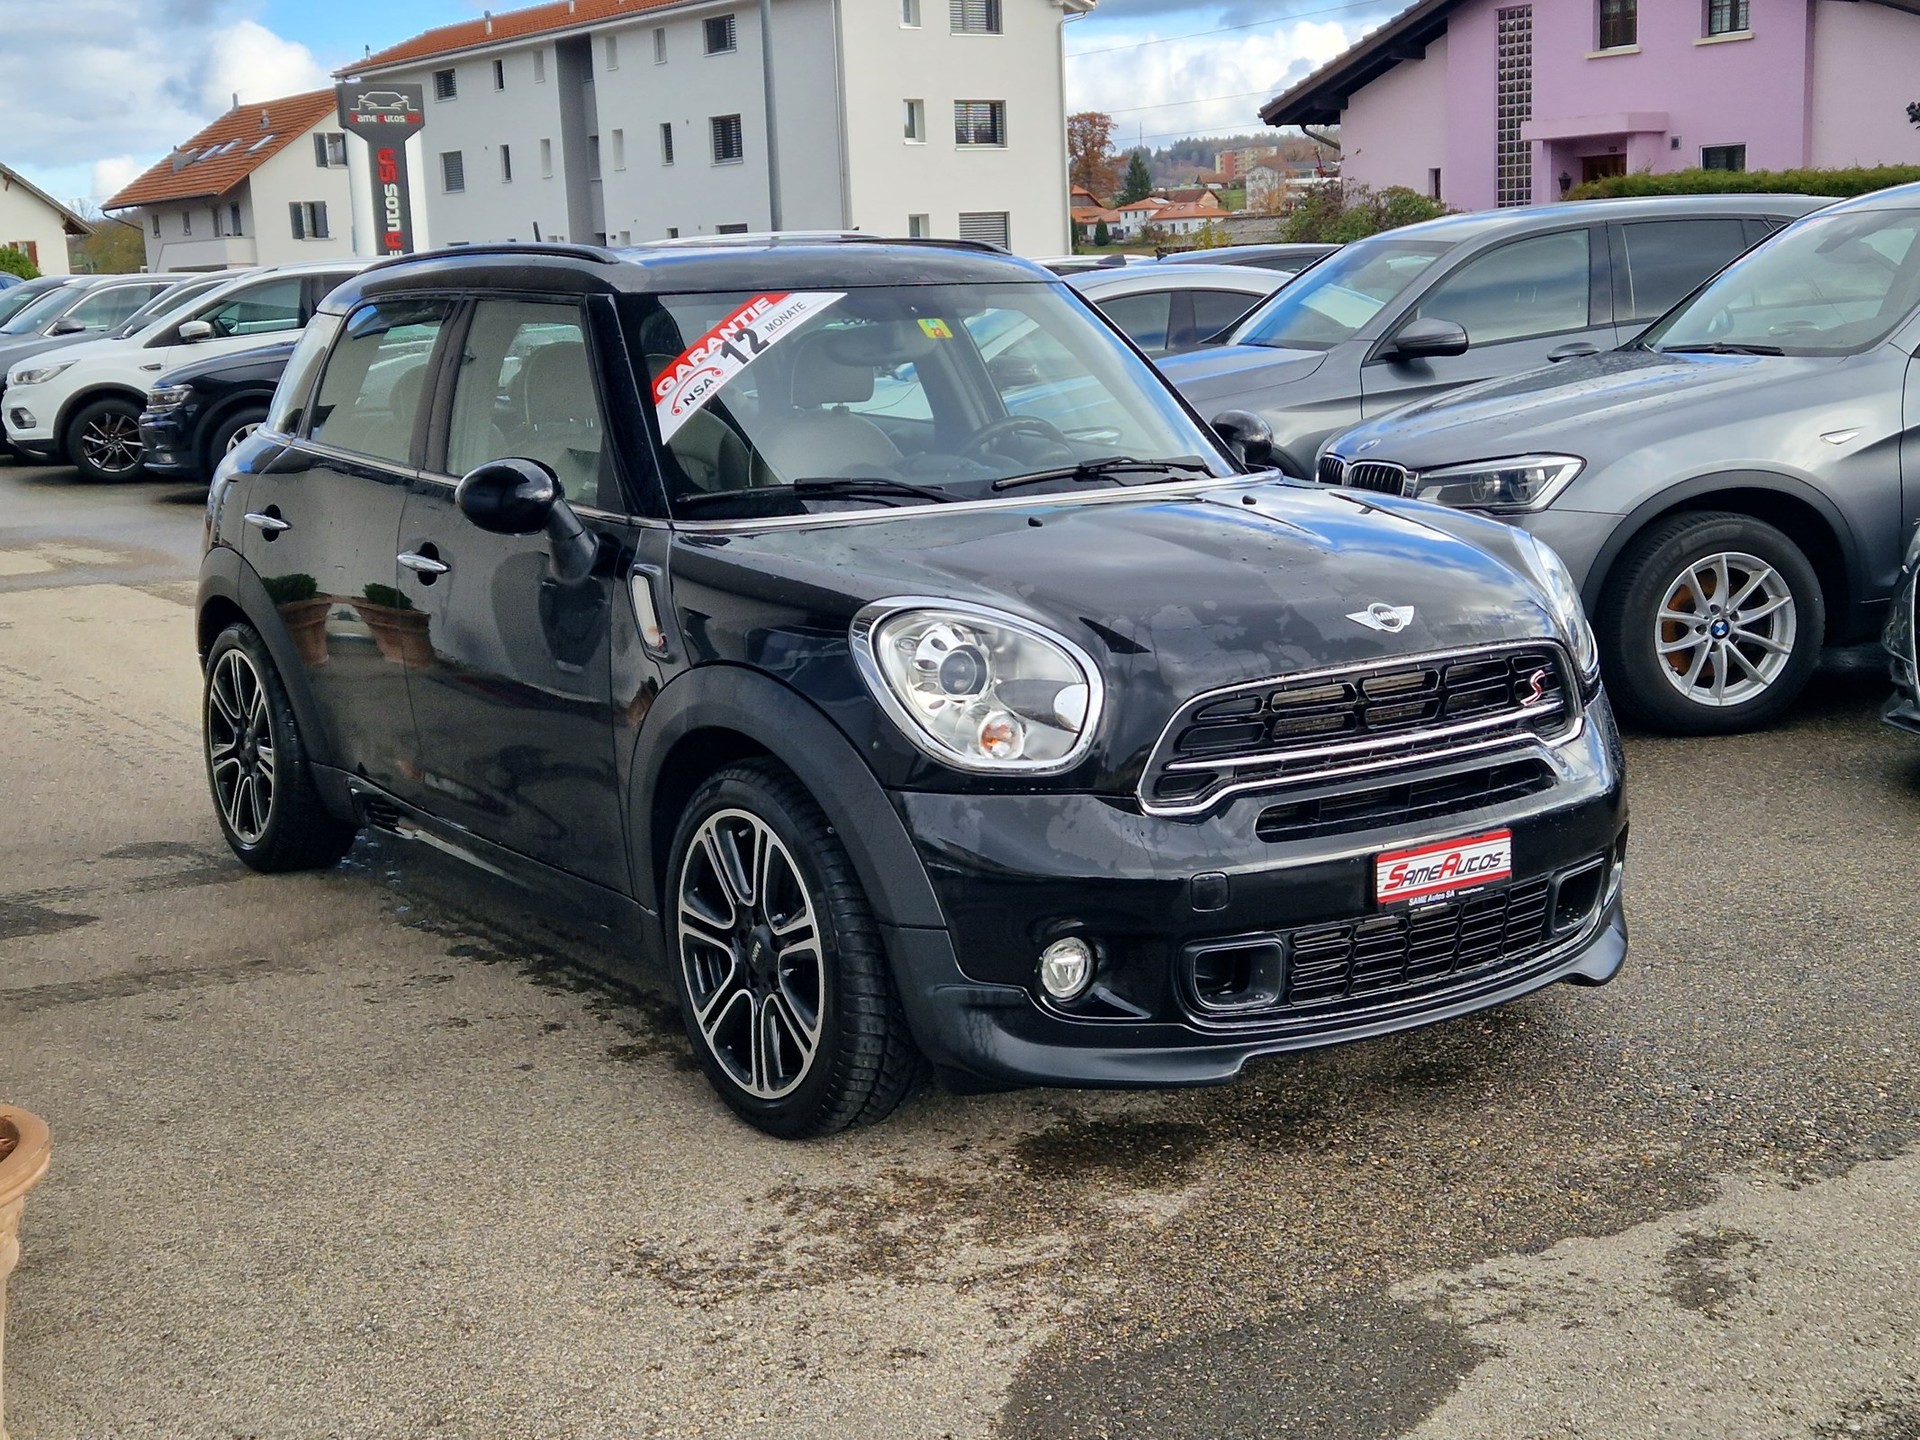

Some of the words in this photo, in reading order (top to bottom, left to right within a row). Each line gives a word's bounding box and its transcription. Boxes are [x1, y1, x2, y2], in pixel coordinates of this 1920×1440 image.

[656, 297, 774, 396] GARANTIE
[720, 328, 770, 365] 12
[764, 301, 807, 333] MONATE
[683, 377, 714, 406] NSA
[1374, 610, 1398, 621] MINI
[1408, 896, 1428, 906] SAME
[1446, 890, 1455, 899] SA
